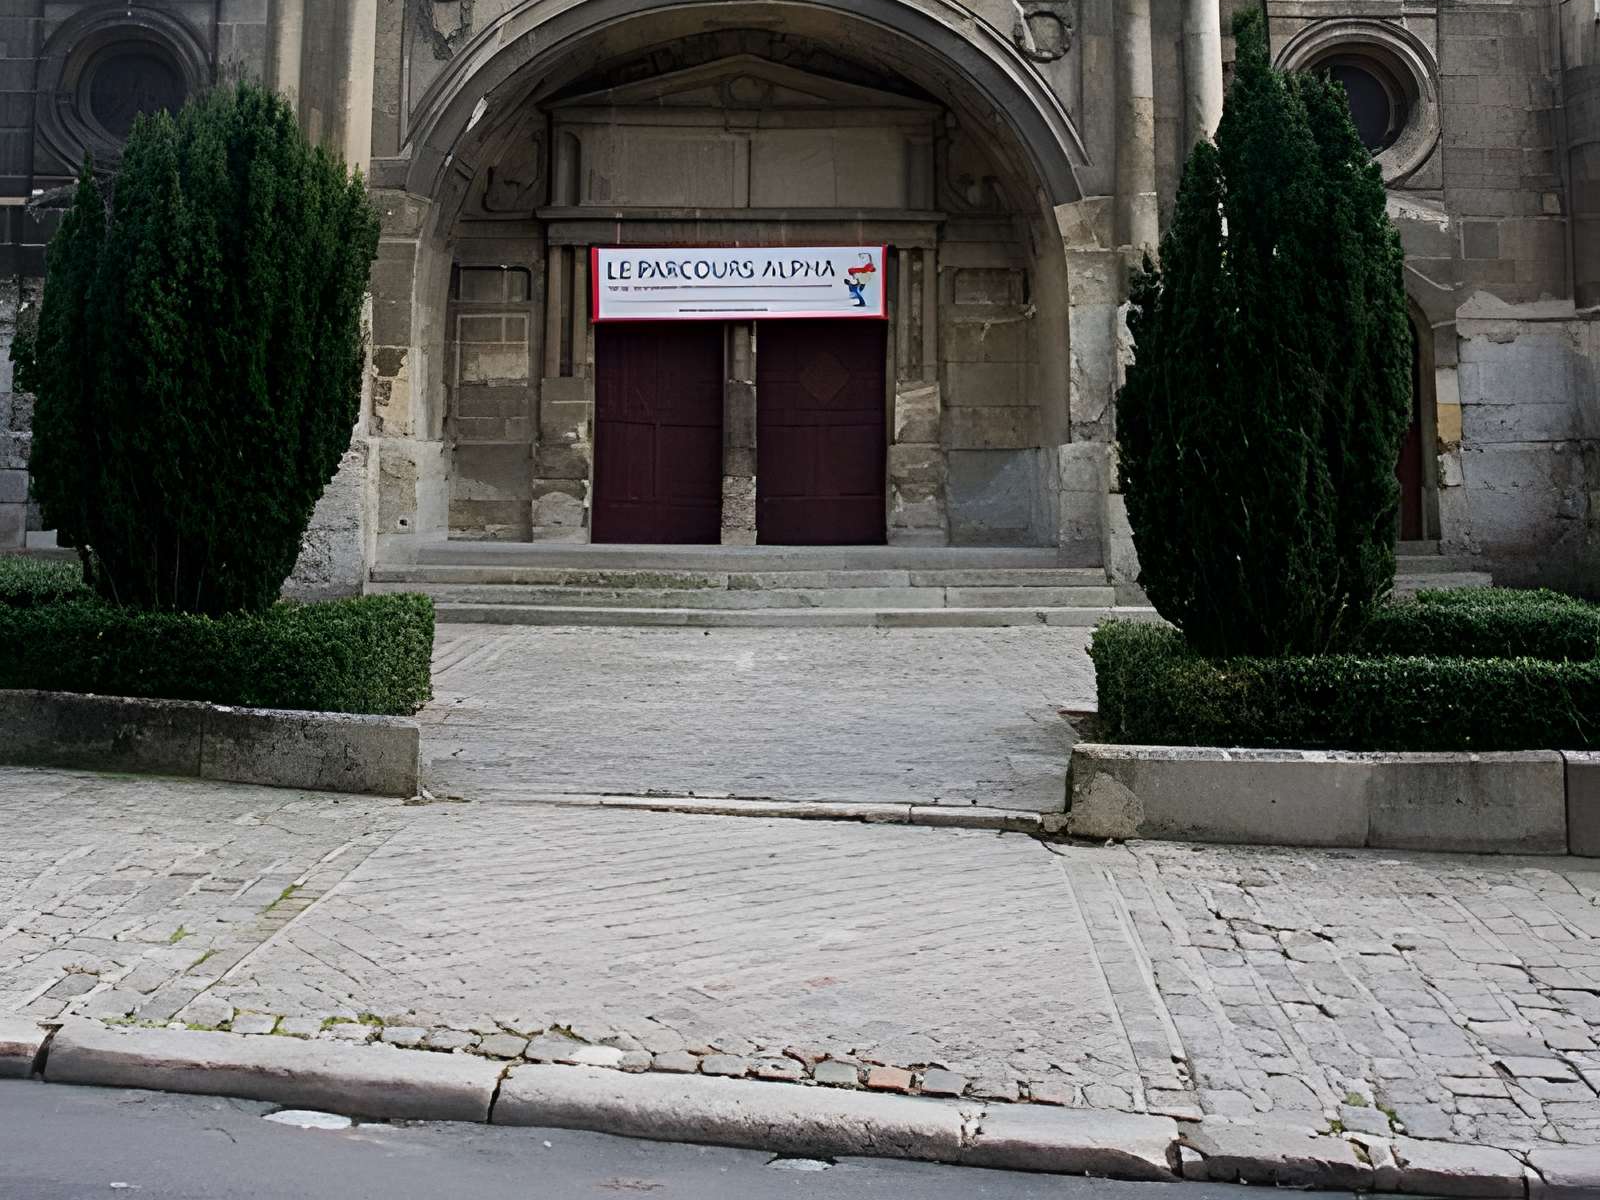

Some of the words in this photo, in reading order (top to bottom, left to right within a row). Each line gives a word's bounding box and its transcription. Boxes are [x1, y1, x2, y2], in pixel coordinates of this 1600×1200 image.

[607, 261, 632, 280] LE
[638, 260, 754, 279] PARCOURS
[762, 259, 835, 278] ALPHA
